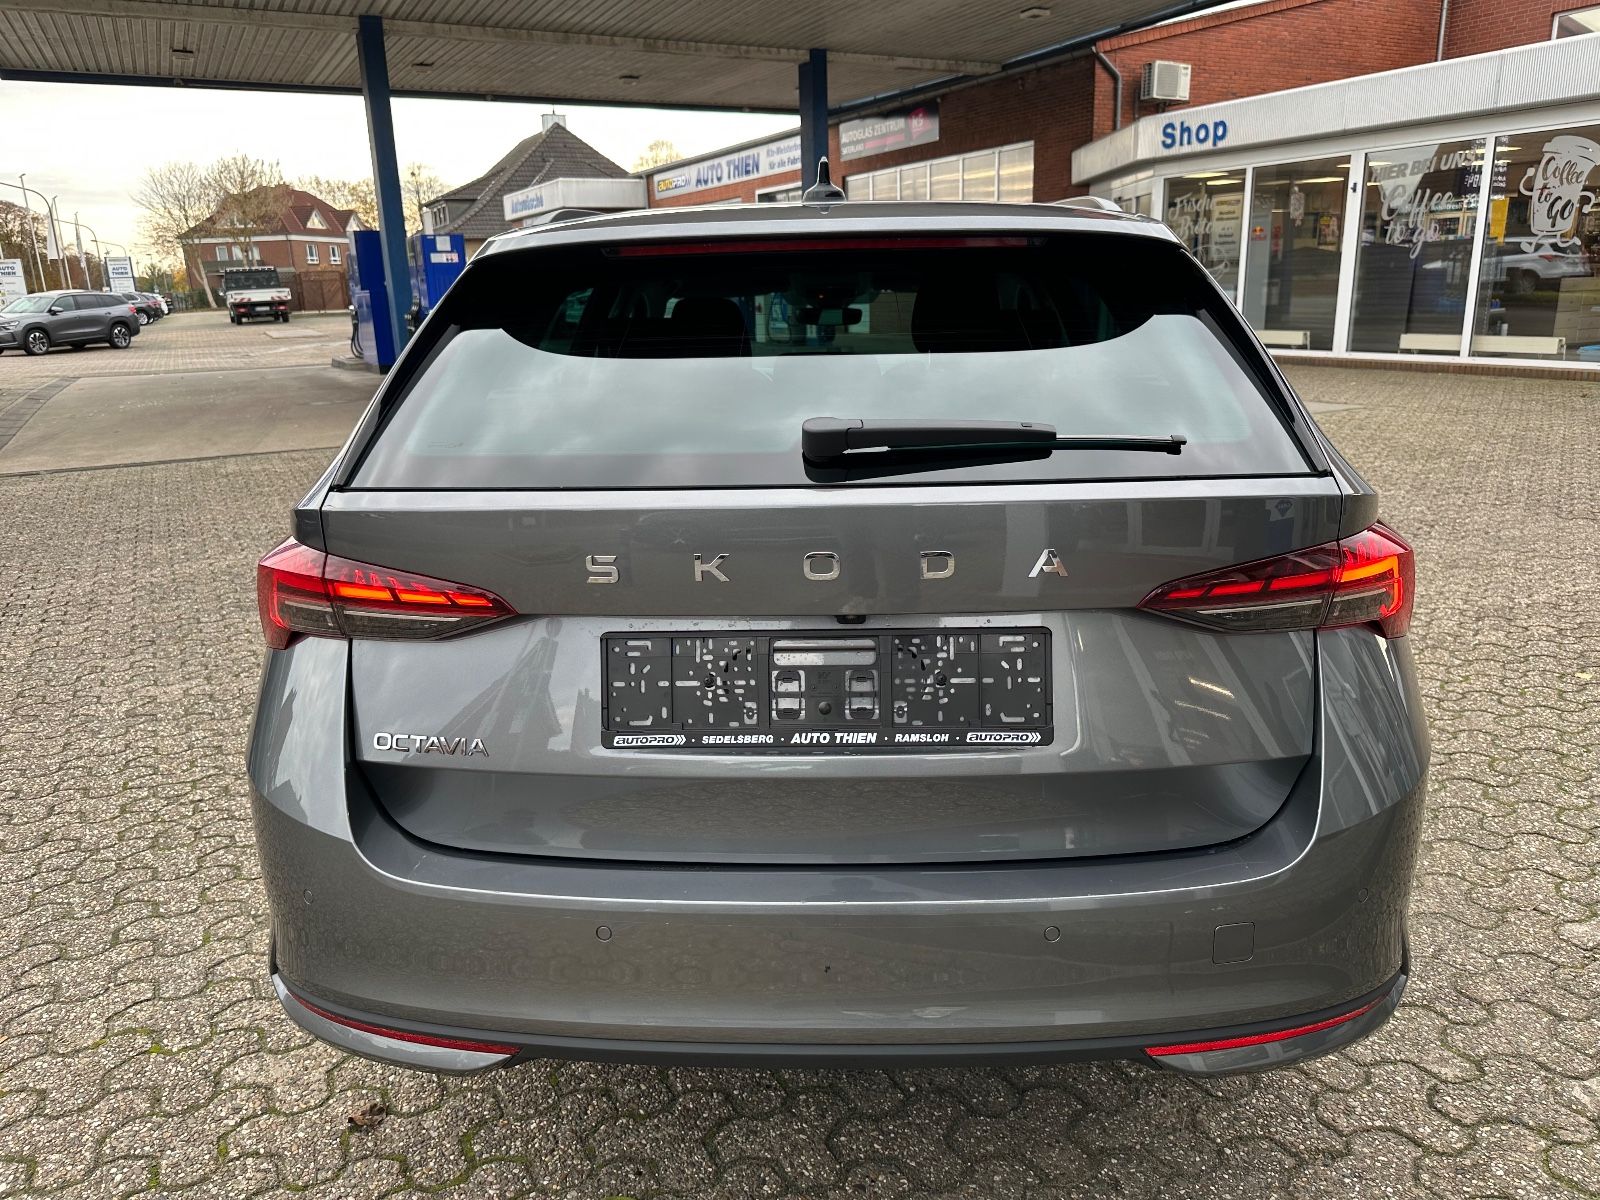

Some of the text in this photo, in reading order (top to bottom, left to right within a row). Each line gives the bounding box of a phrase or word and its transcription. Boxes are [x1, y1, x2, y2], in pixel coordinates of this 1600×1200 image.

[1161, 120, 1228, 149] Shop
[695, 161, 723, 188] AUTO
[726, 153, 760, 182] THIEN
[1371, 163, 1408, 182] HIER
[1409, 156, 1437, 176] BEI
[1541, 155, 1584, 187] Coffee
[1380, 185, 1454, 228] Coffee
[1535, 182, 1552, 203] to
[1546, 195, 1575, 228] GO
[1384, 221, 1441, 259] to go
[586, 548, 1069, 584] SKODA
[373, 732, 490, 757] OCTAVIA
[702, 735, 774, 744] SEDELSBERG
[790, 733, 830, 744] AUTO
[834, 733, 877, 744] THIEN
[894, 733, 950, 743] RAMSLOH
